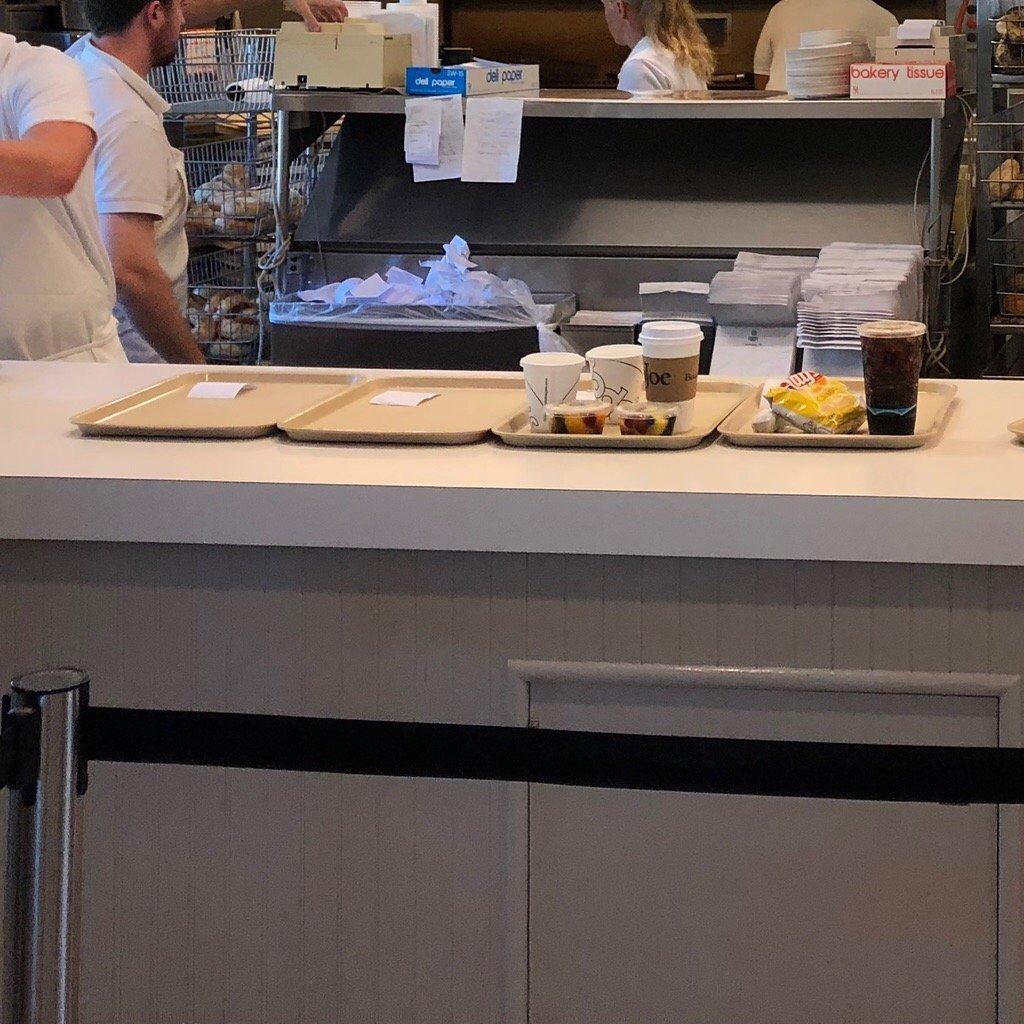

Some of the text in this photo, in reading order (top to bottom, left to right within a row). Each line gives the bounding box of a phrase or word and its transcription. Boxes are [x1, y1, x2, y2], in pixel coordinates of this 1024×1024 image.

[485, 69, 524, 85] deli paper
[851, 66, 945, 81] bakery tissue
[414, 78, 456, 88] deli paper
[644, 363, 672, 389] Joe
